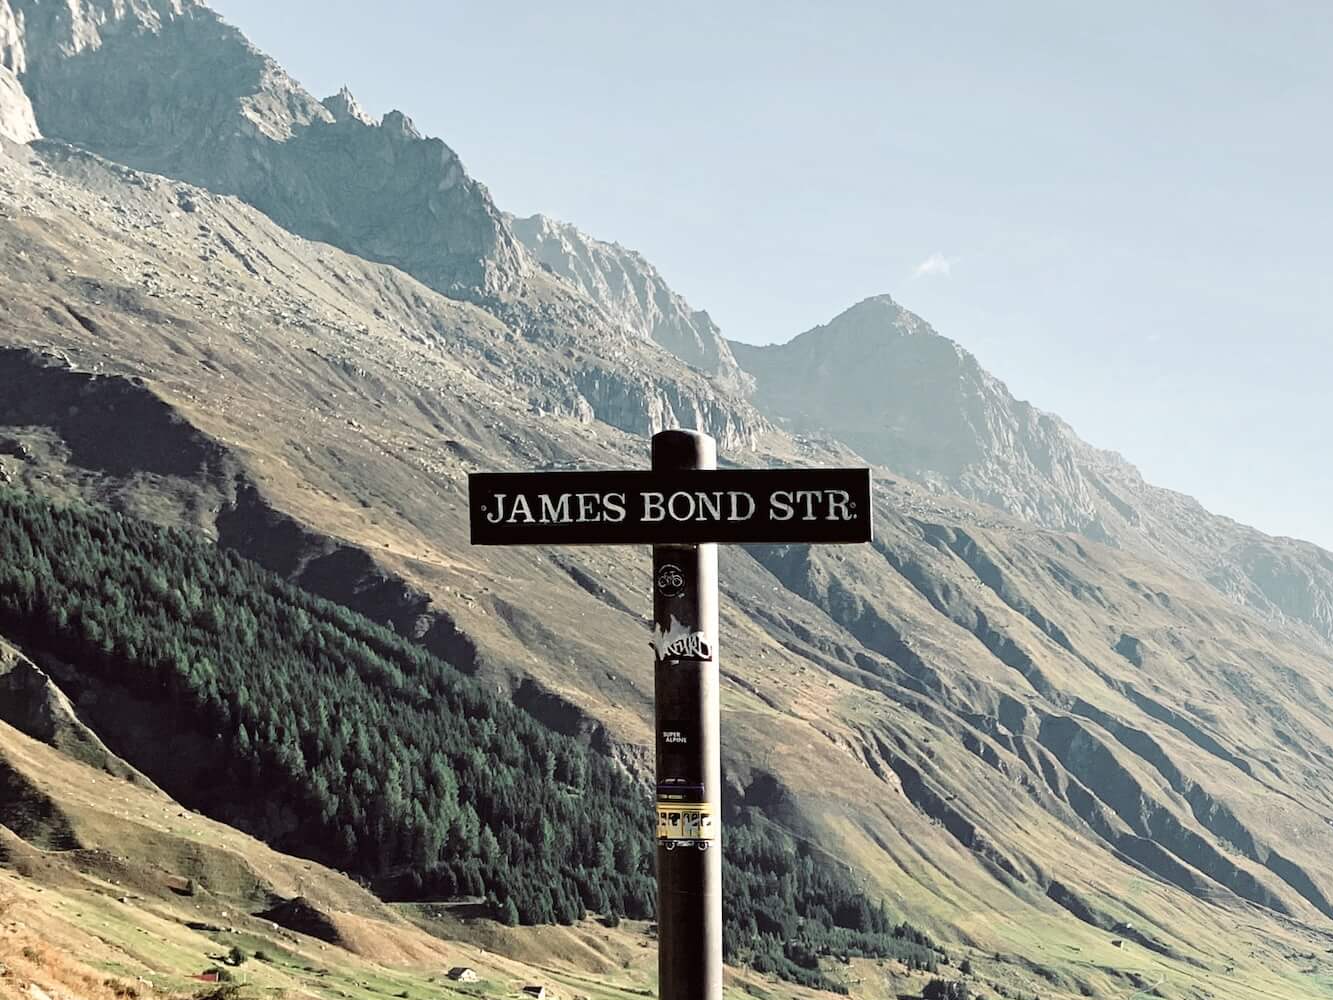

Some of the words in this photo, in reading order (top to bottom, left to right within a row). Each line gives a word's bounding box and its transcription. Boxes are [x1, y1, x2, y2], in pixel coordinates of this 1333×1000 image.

[486, 493, 627, 524] JAMES
[639, 490, 756, 522] BOND
[768, 489, 858, 521] STR.
